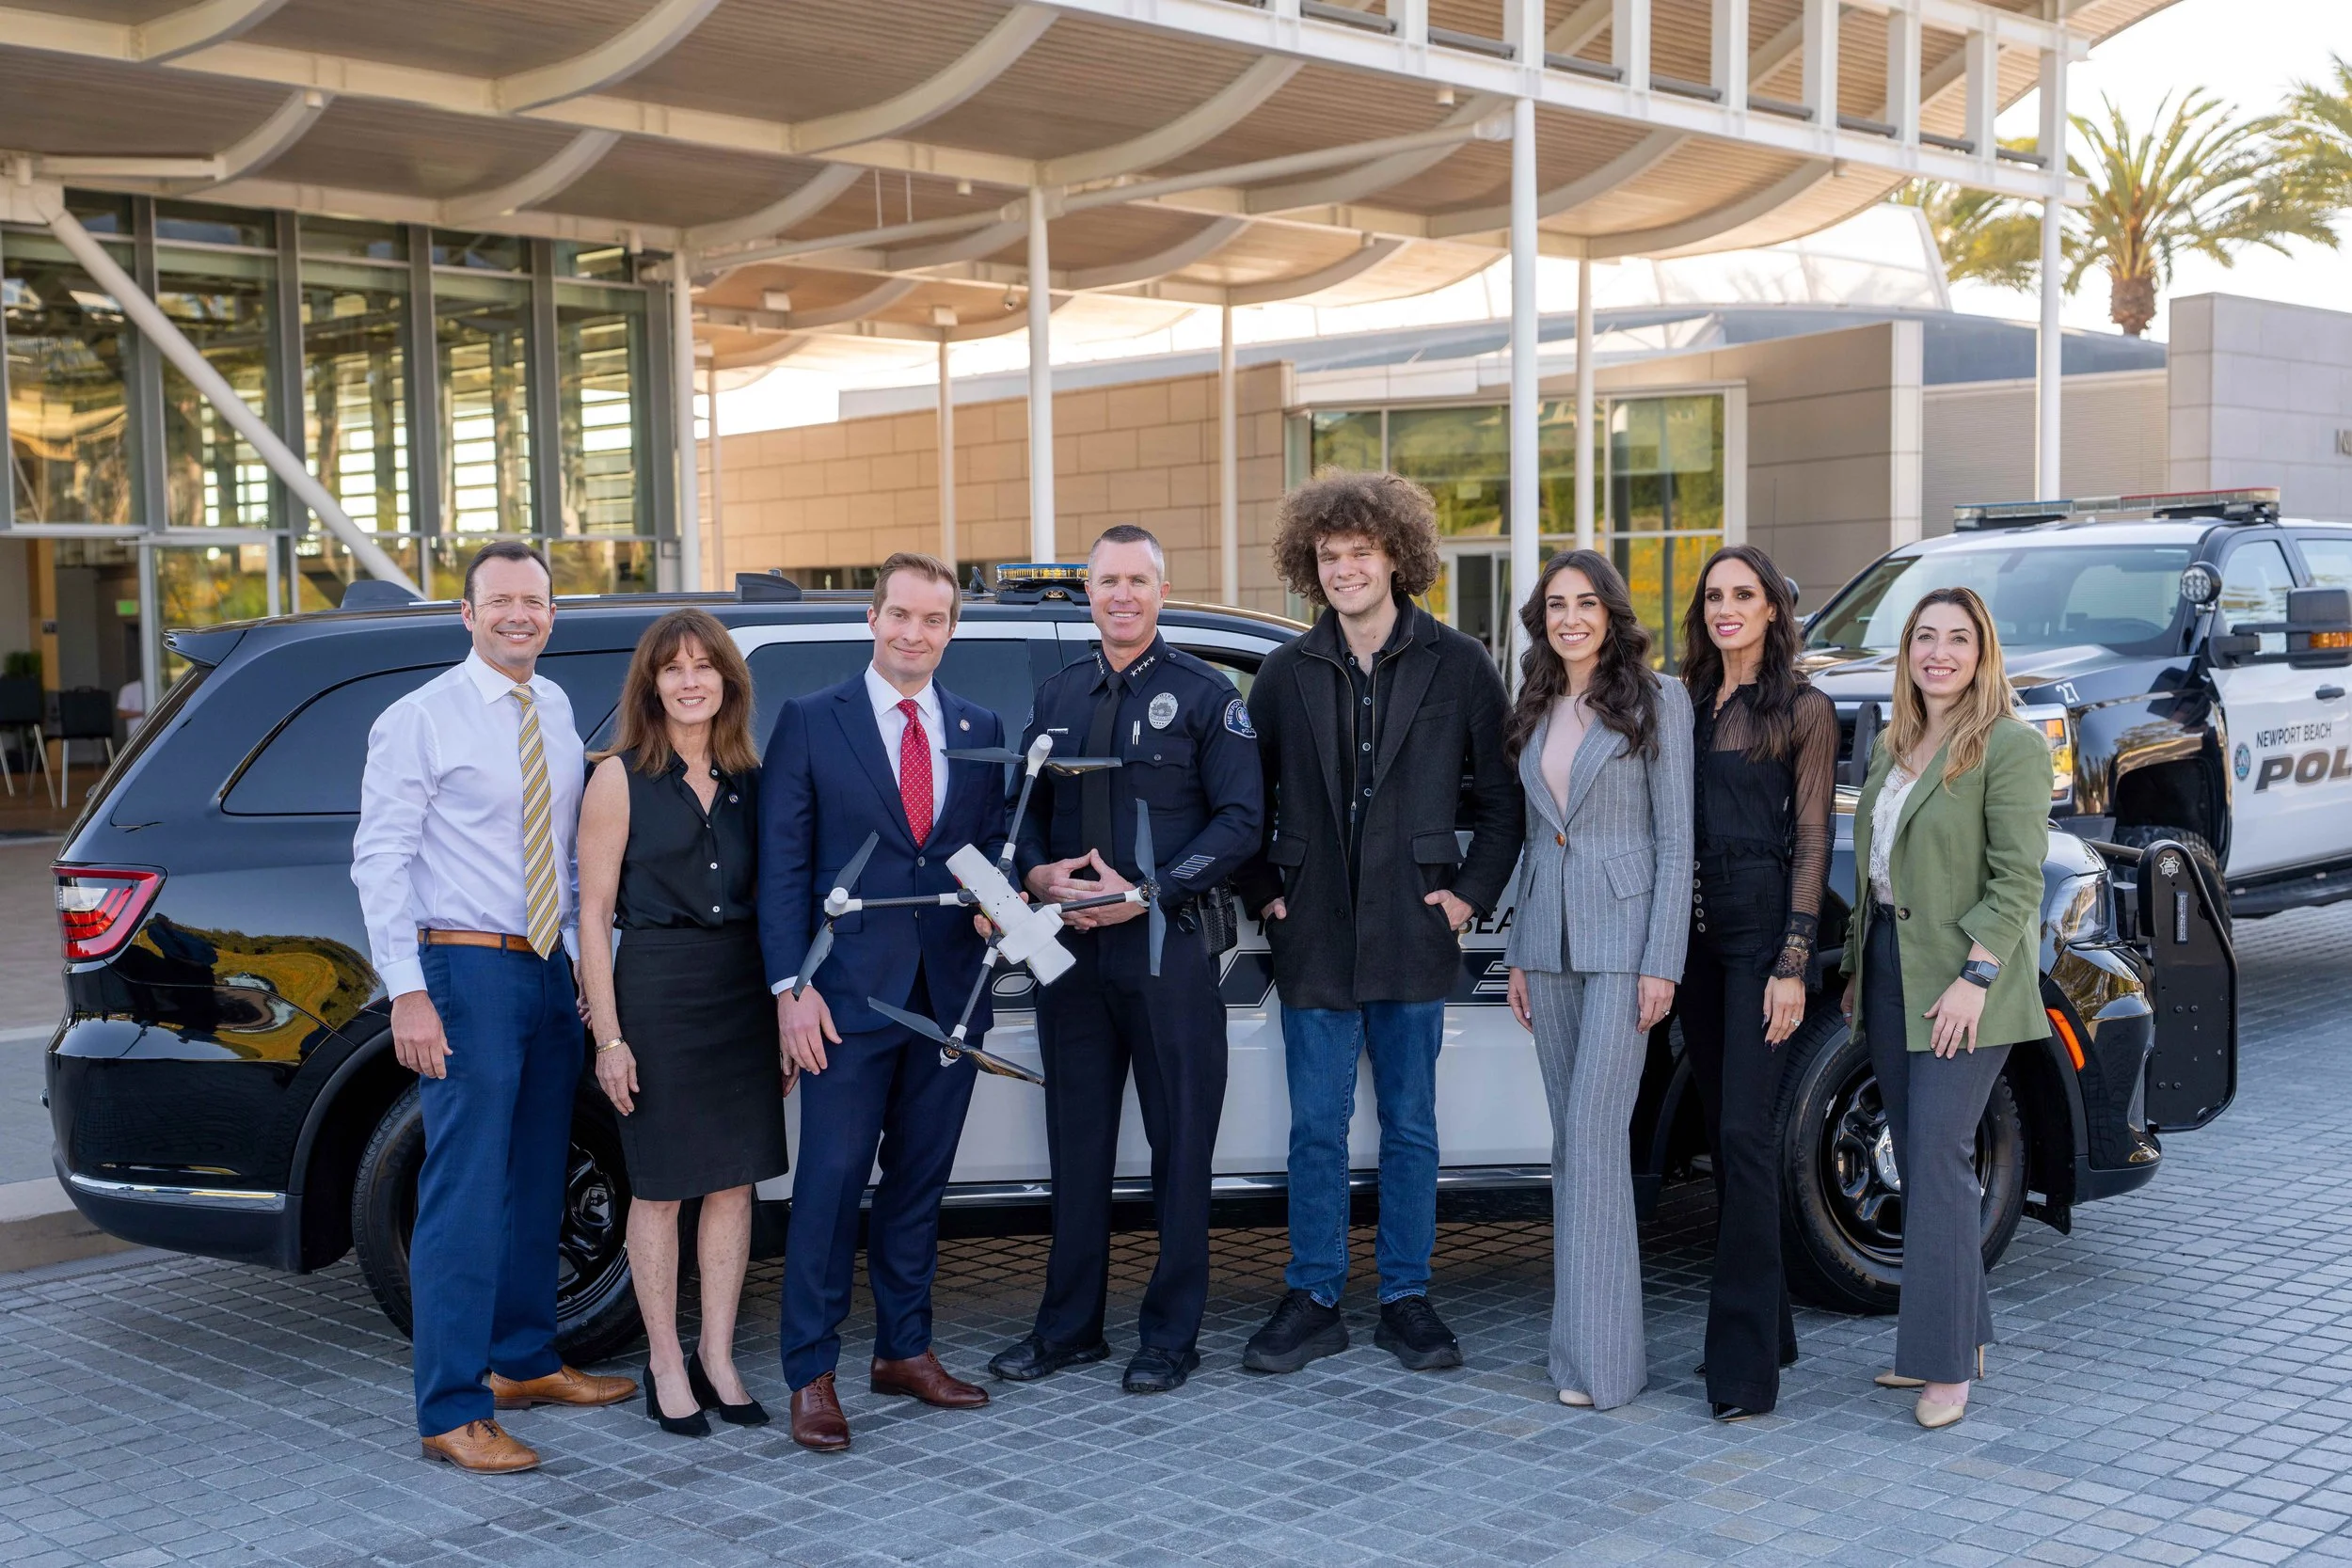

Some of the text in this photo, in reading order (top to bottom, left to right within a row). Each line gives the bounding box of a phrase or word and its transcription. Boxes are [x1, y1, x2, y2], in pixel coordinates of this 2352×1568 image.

[2055, 682, 2080, 704] 27
[2256, 721, 2332, 749] NEWPORT BEACH
[2253, 745, 2352, 794] POL
